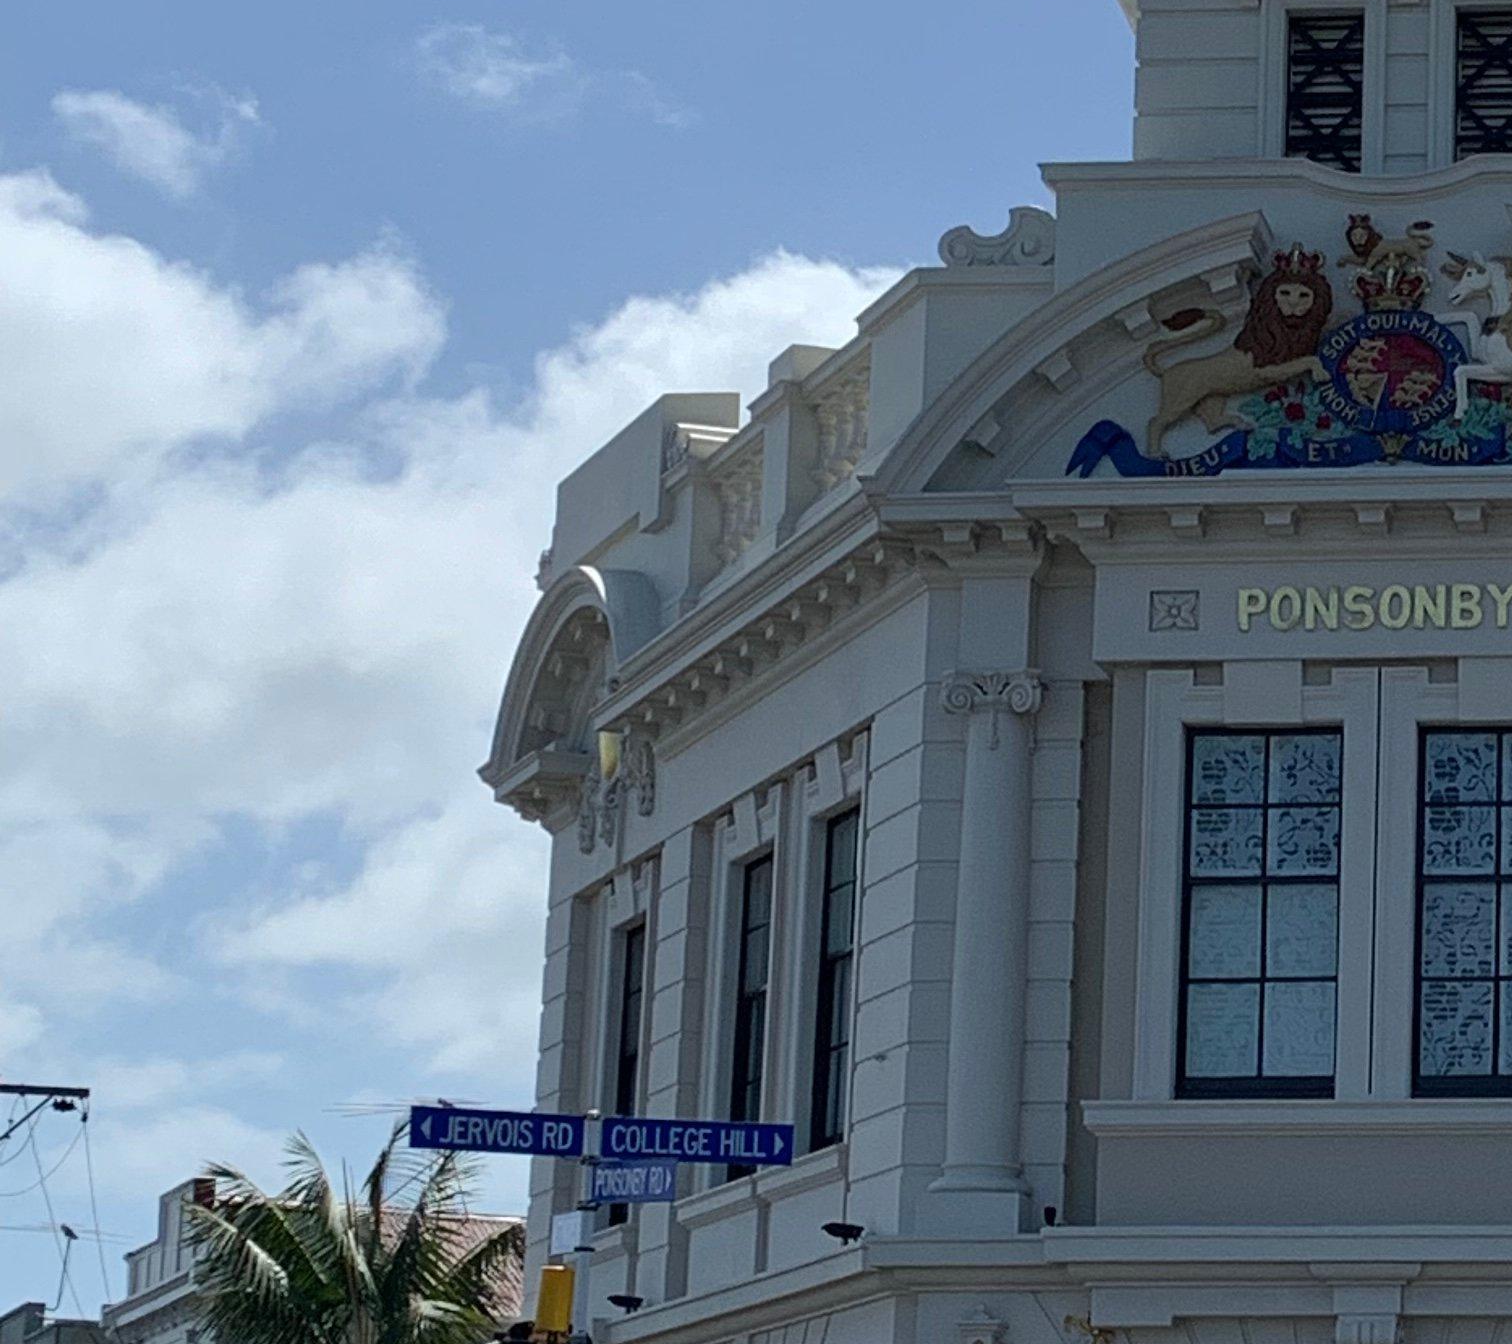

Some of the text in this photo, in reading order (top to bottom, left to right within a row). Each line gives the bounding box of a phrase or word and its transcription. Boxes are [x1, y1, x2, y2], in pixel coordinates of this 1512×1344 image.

[1366, 313, 1401, 331] QUI
[1408, 318, 1448, 349] MAL
[1322, 323, 1357, 361] SOIT
[1319, 381, 1360, 429] HONI
[1411, 387, 1456, 426] PENSE
[1165, 447, 1220, 477] DIEU
[1308, 442, 1338, 462] ET
[1417, 439, 1469, 462] MON
[439, 1115, 573, 1150] JERVOIS RD
[610, 1124, 767, 1158] COLLEGE HILL
[595, 1167, 664, 1197] PONSONBY RD
